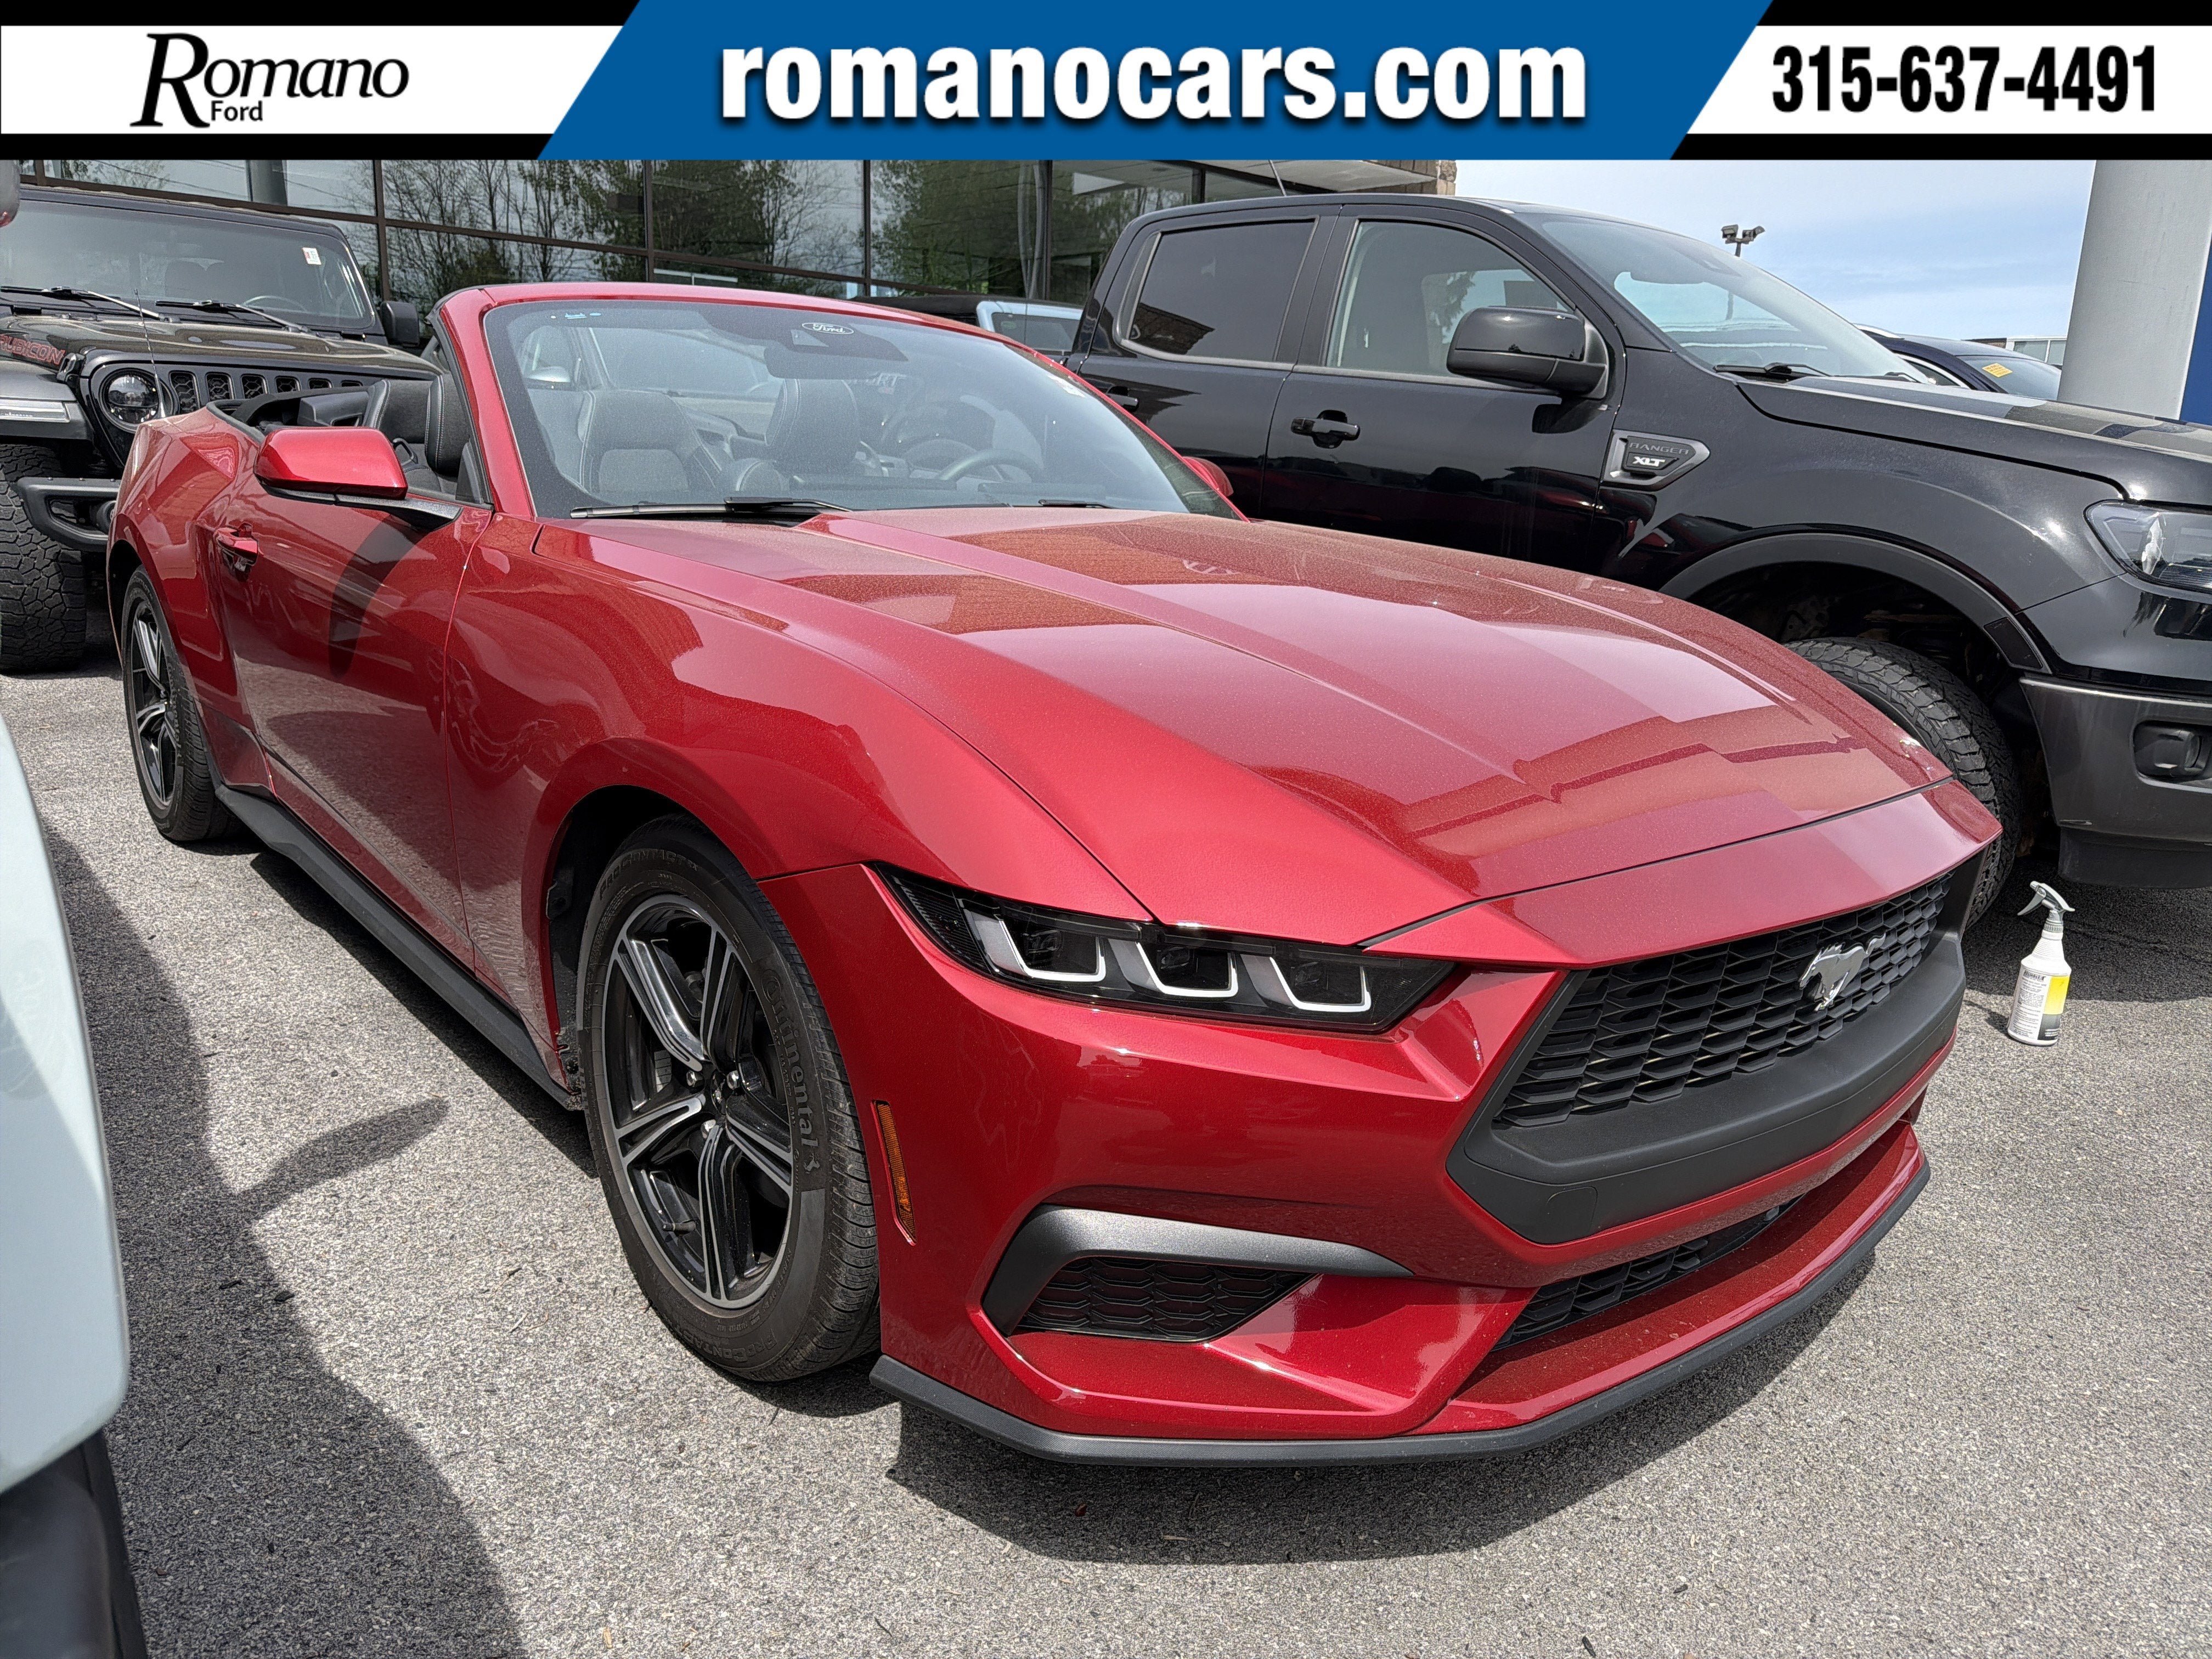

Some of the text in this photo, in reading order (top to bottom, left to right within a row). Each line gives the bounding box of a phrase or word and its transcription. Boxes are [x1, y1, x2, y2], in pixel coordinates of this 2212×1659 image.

[812, 323, 845, 333] Ford
[1629, 442, 1689, 455] RANGER
[1632, 456, 1666, 467] XLT
[761, 968, 819, 1147] Continental
